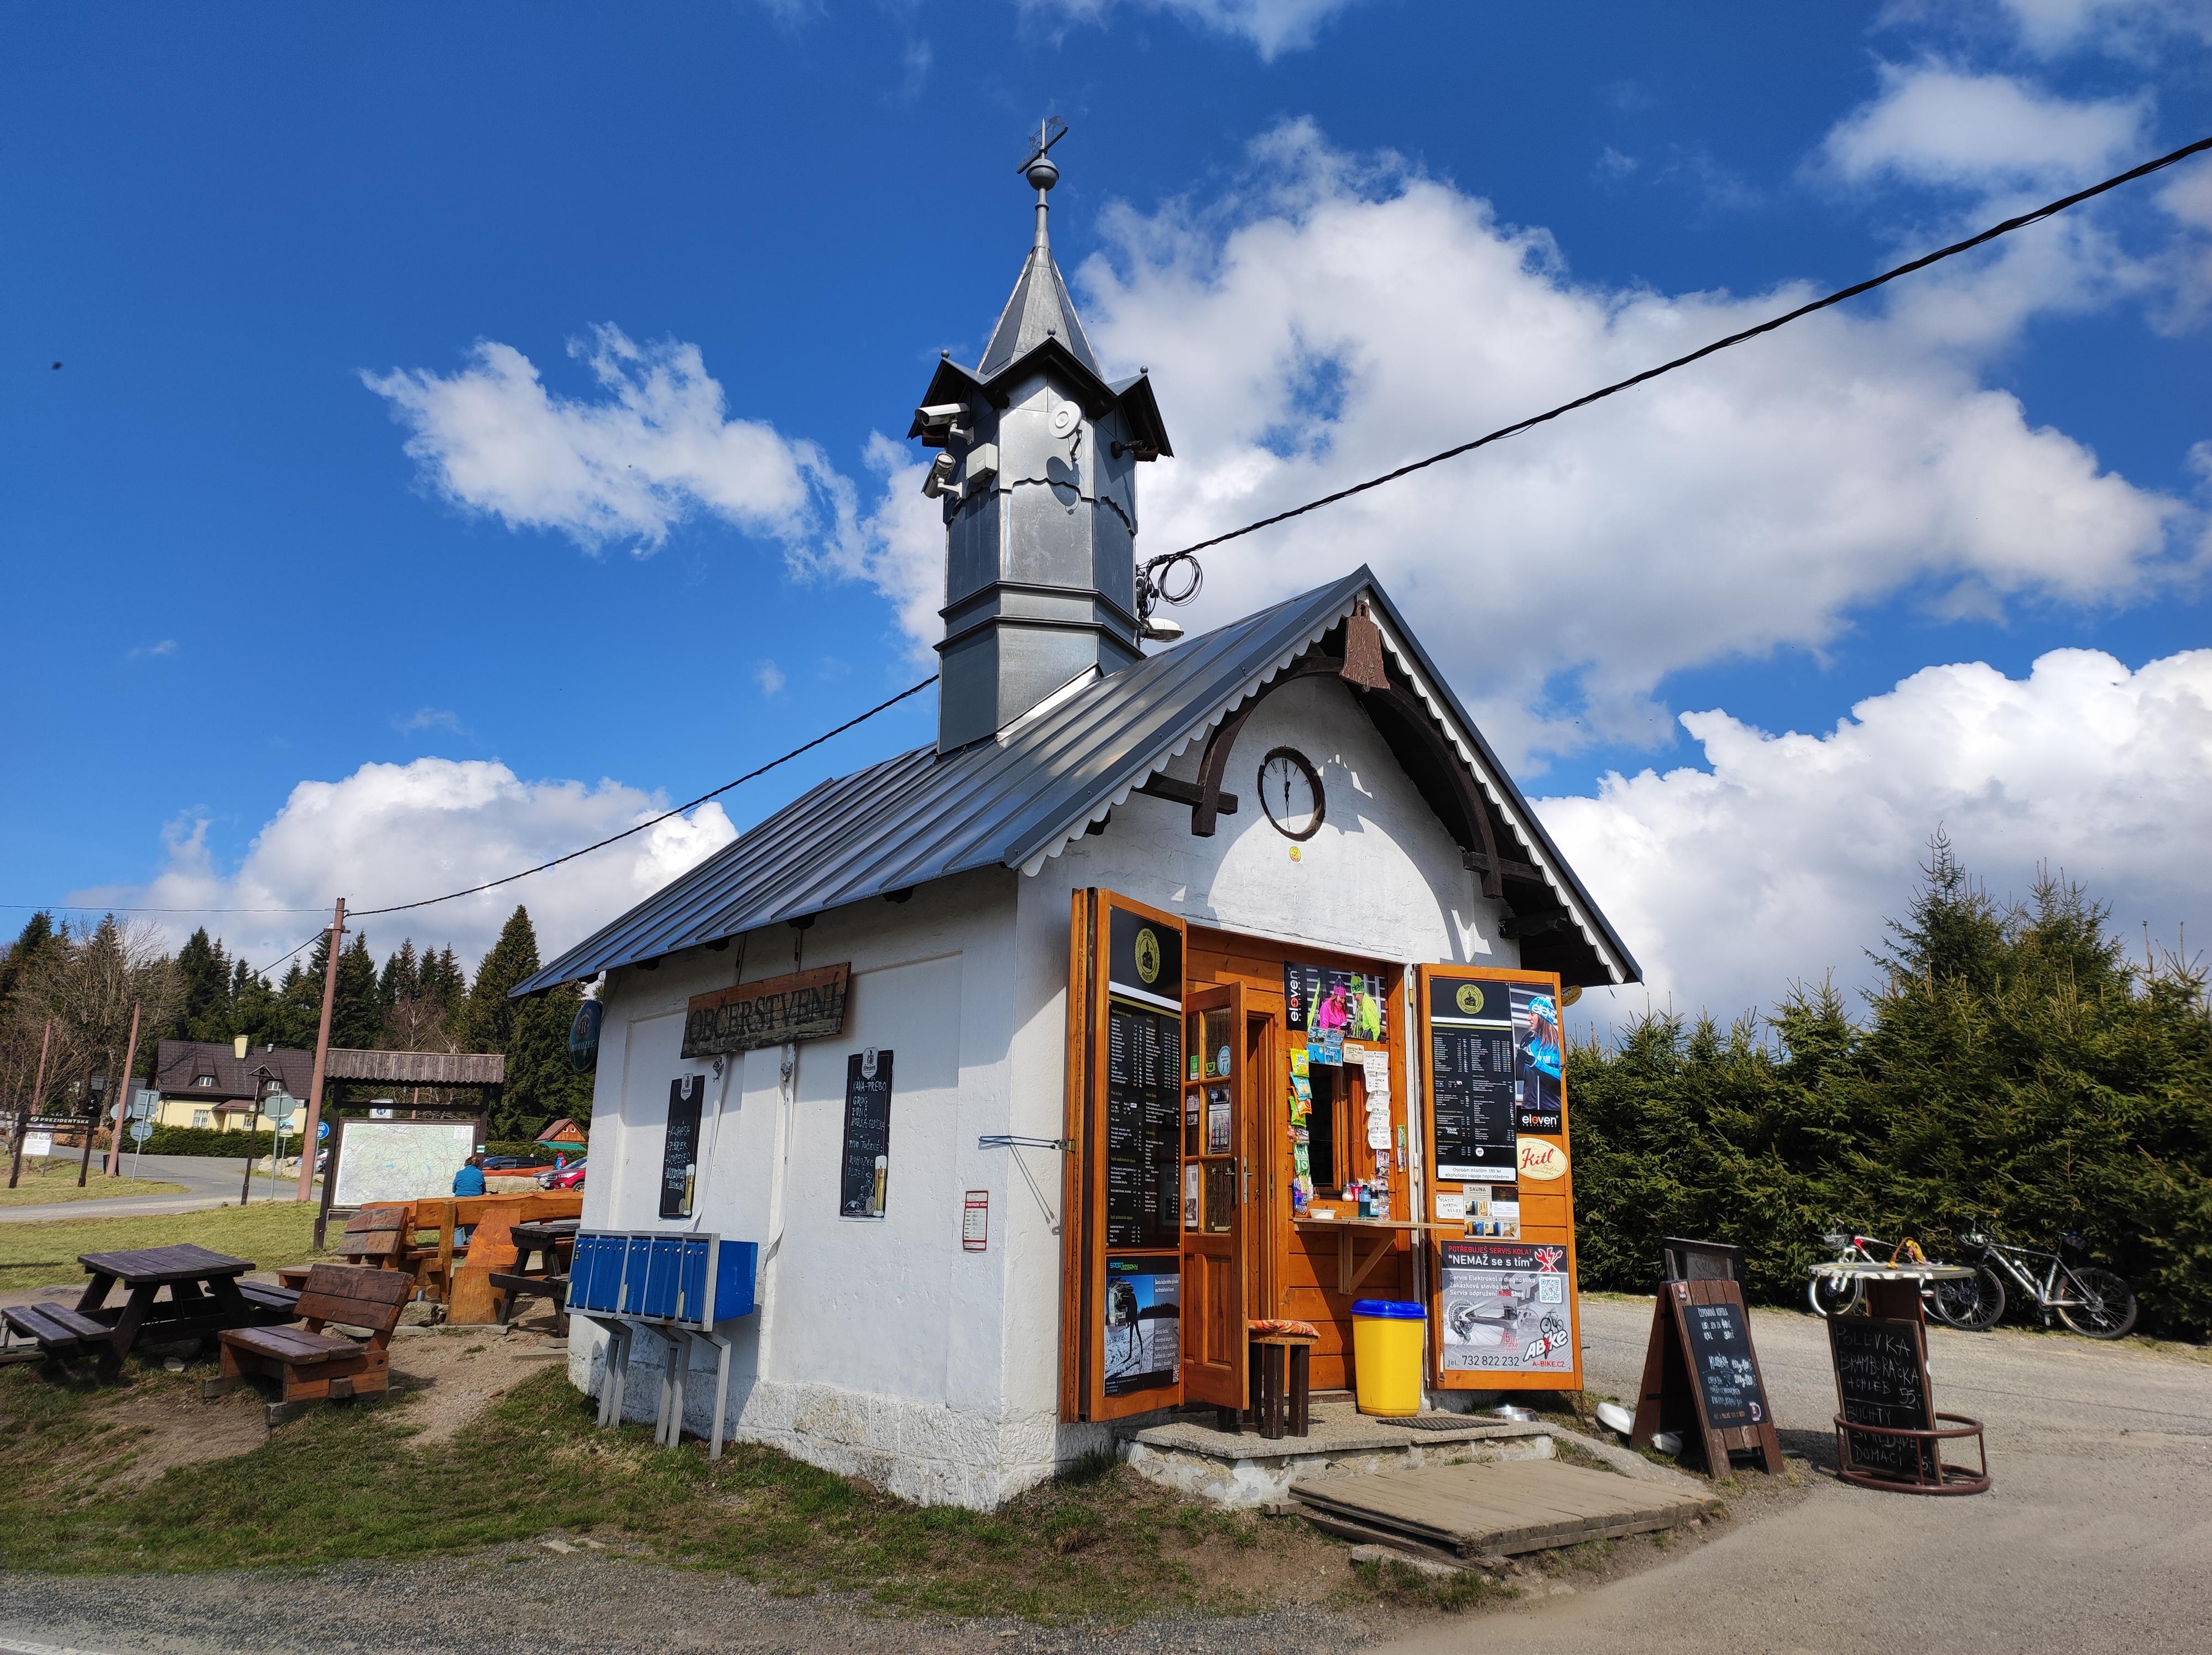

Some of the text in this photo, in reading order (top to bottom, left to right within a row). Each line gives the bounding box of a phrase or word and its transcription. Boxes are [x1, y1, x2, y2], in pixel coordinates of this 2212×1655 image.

[690, 971, 839, 1041] OBČERSTVENÍ
[571, 1040, 595, 1052] ROHOZEC
[853, 1095, 868, 1107] GROG
[852, 1105, 868, 1117] PUNČ
[1520, 1148, 1554, 1170] Kitl
[1503, 1333, 1510, 1342] 15
[1462, 1355, 1480, 1366] 732
[1482, 1356, 1500, 1366] 822
[1502, 1356, 1520, 1367] 232
[1839, 1351, 1919, 1386] BRAMBORAČKA
[1847, 1405, 1891, 1426] BUCHTY
[1854, 1444, 1902, 1467] DOMÁCÍ
